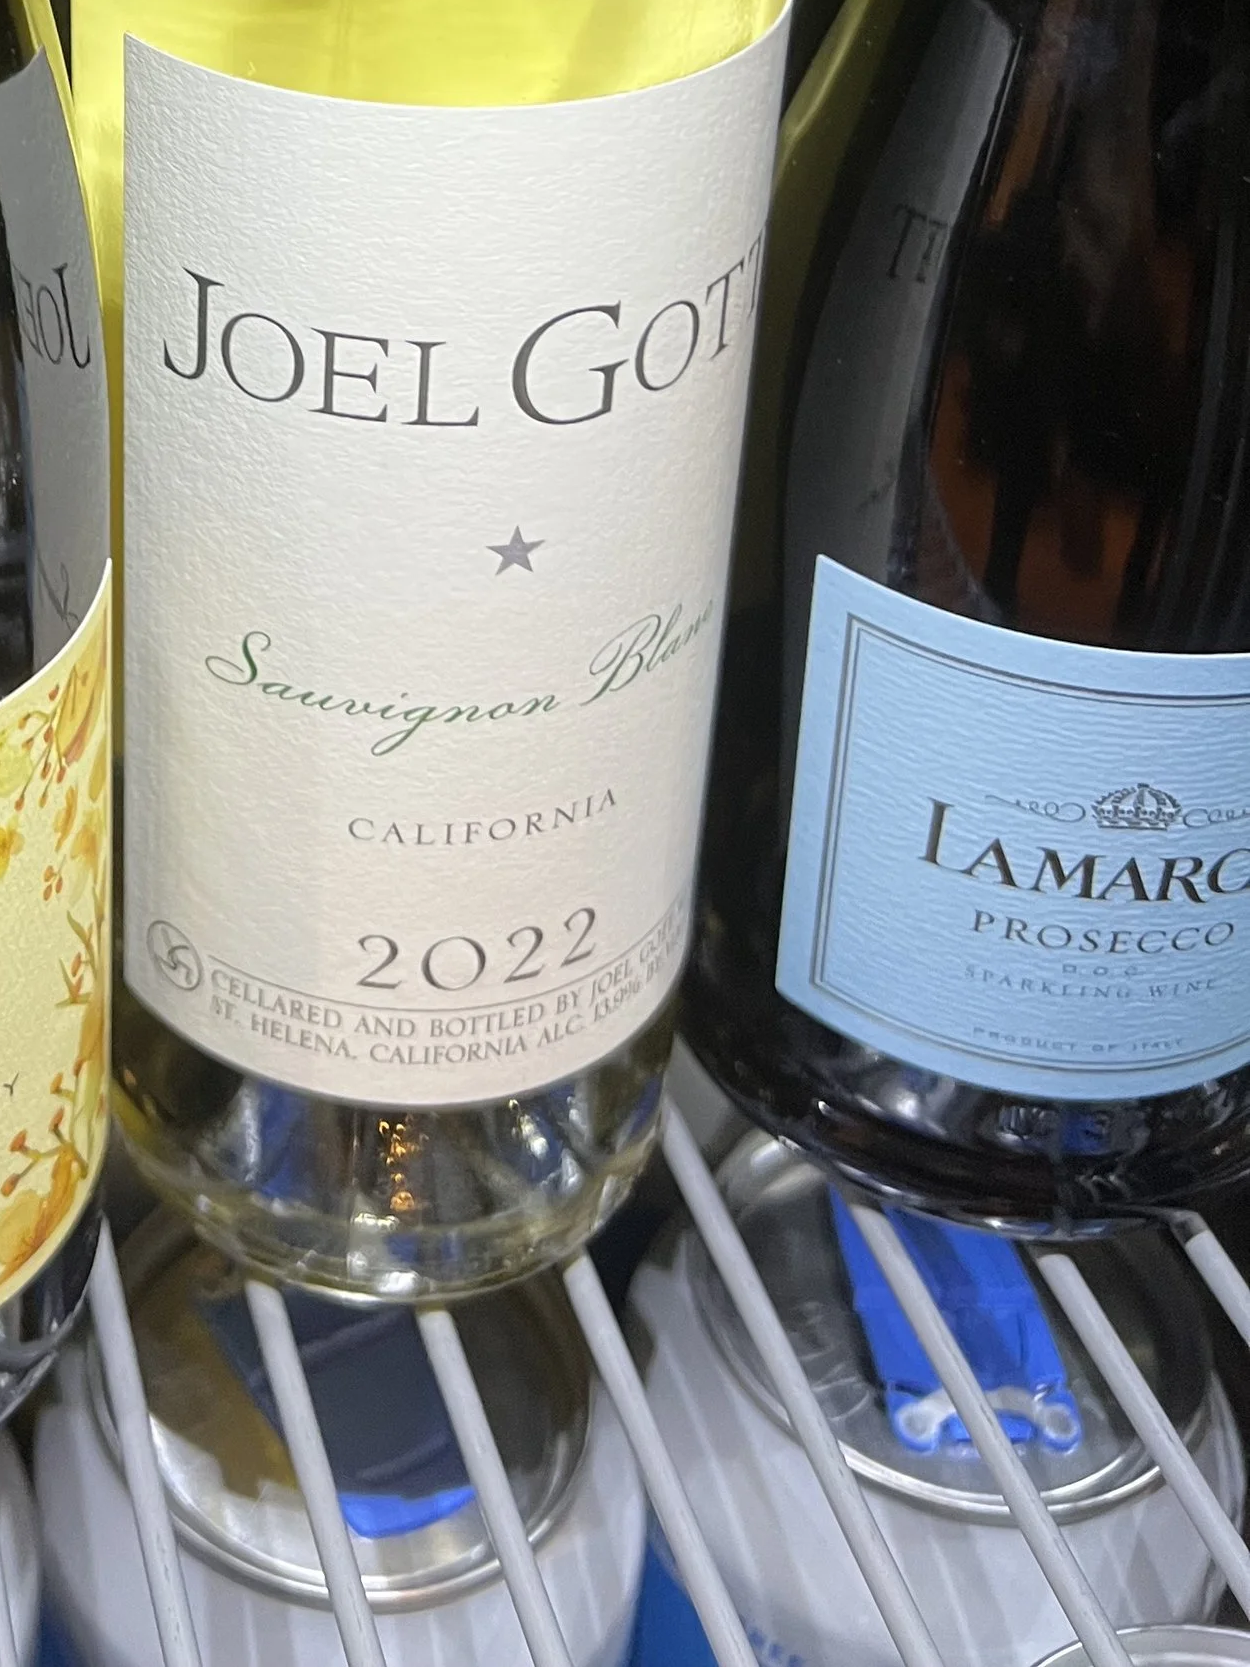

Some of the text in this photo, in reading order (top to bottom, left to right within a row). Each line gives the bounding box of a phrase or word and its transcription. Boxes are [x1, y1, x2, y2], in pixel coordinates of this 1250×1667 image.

[163, 266, 479, 426] JOEL
[206, 631, 561, 756] Sauvignon
[348, 788, 617, 845] CALIFORNIA
[357, 907, 597, 990] 2022
[972, 909, 1234, 954] PROSECCO
[211, 968, 343, 1029] CELLARED
[354, 1013, 415, 1037] AND
[430, 1002, 545, 1037] BOTTLED
[555, 985, 583, 1015] BY
[589, 958, 633, 1008] JOEL
[965, 963, 1218, 999] SPARKLING WINE
[370, 1033, 527, 1065] CALIFORNIA
